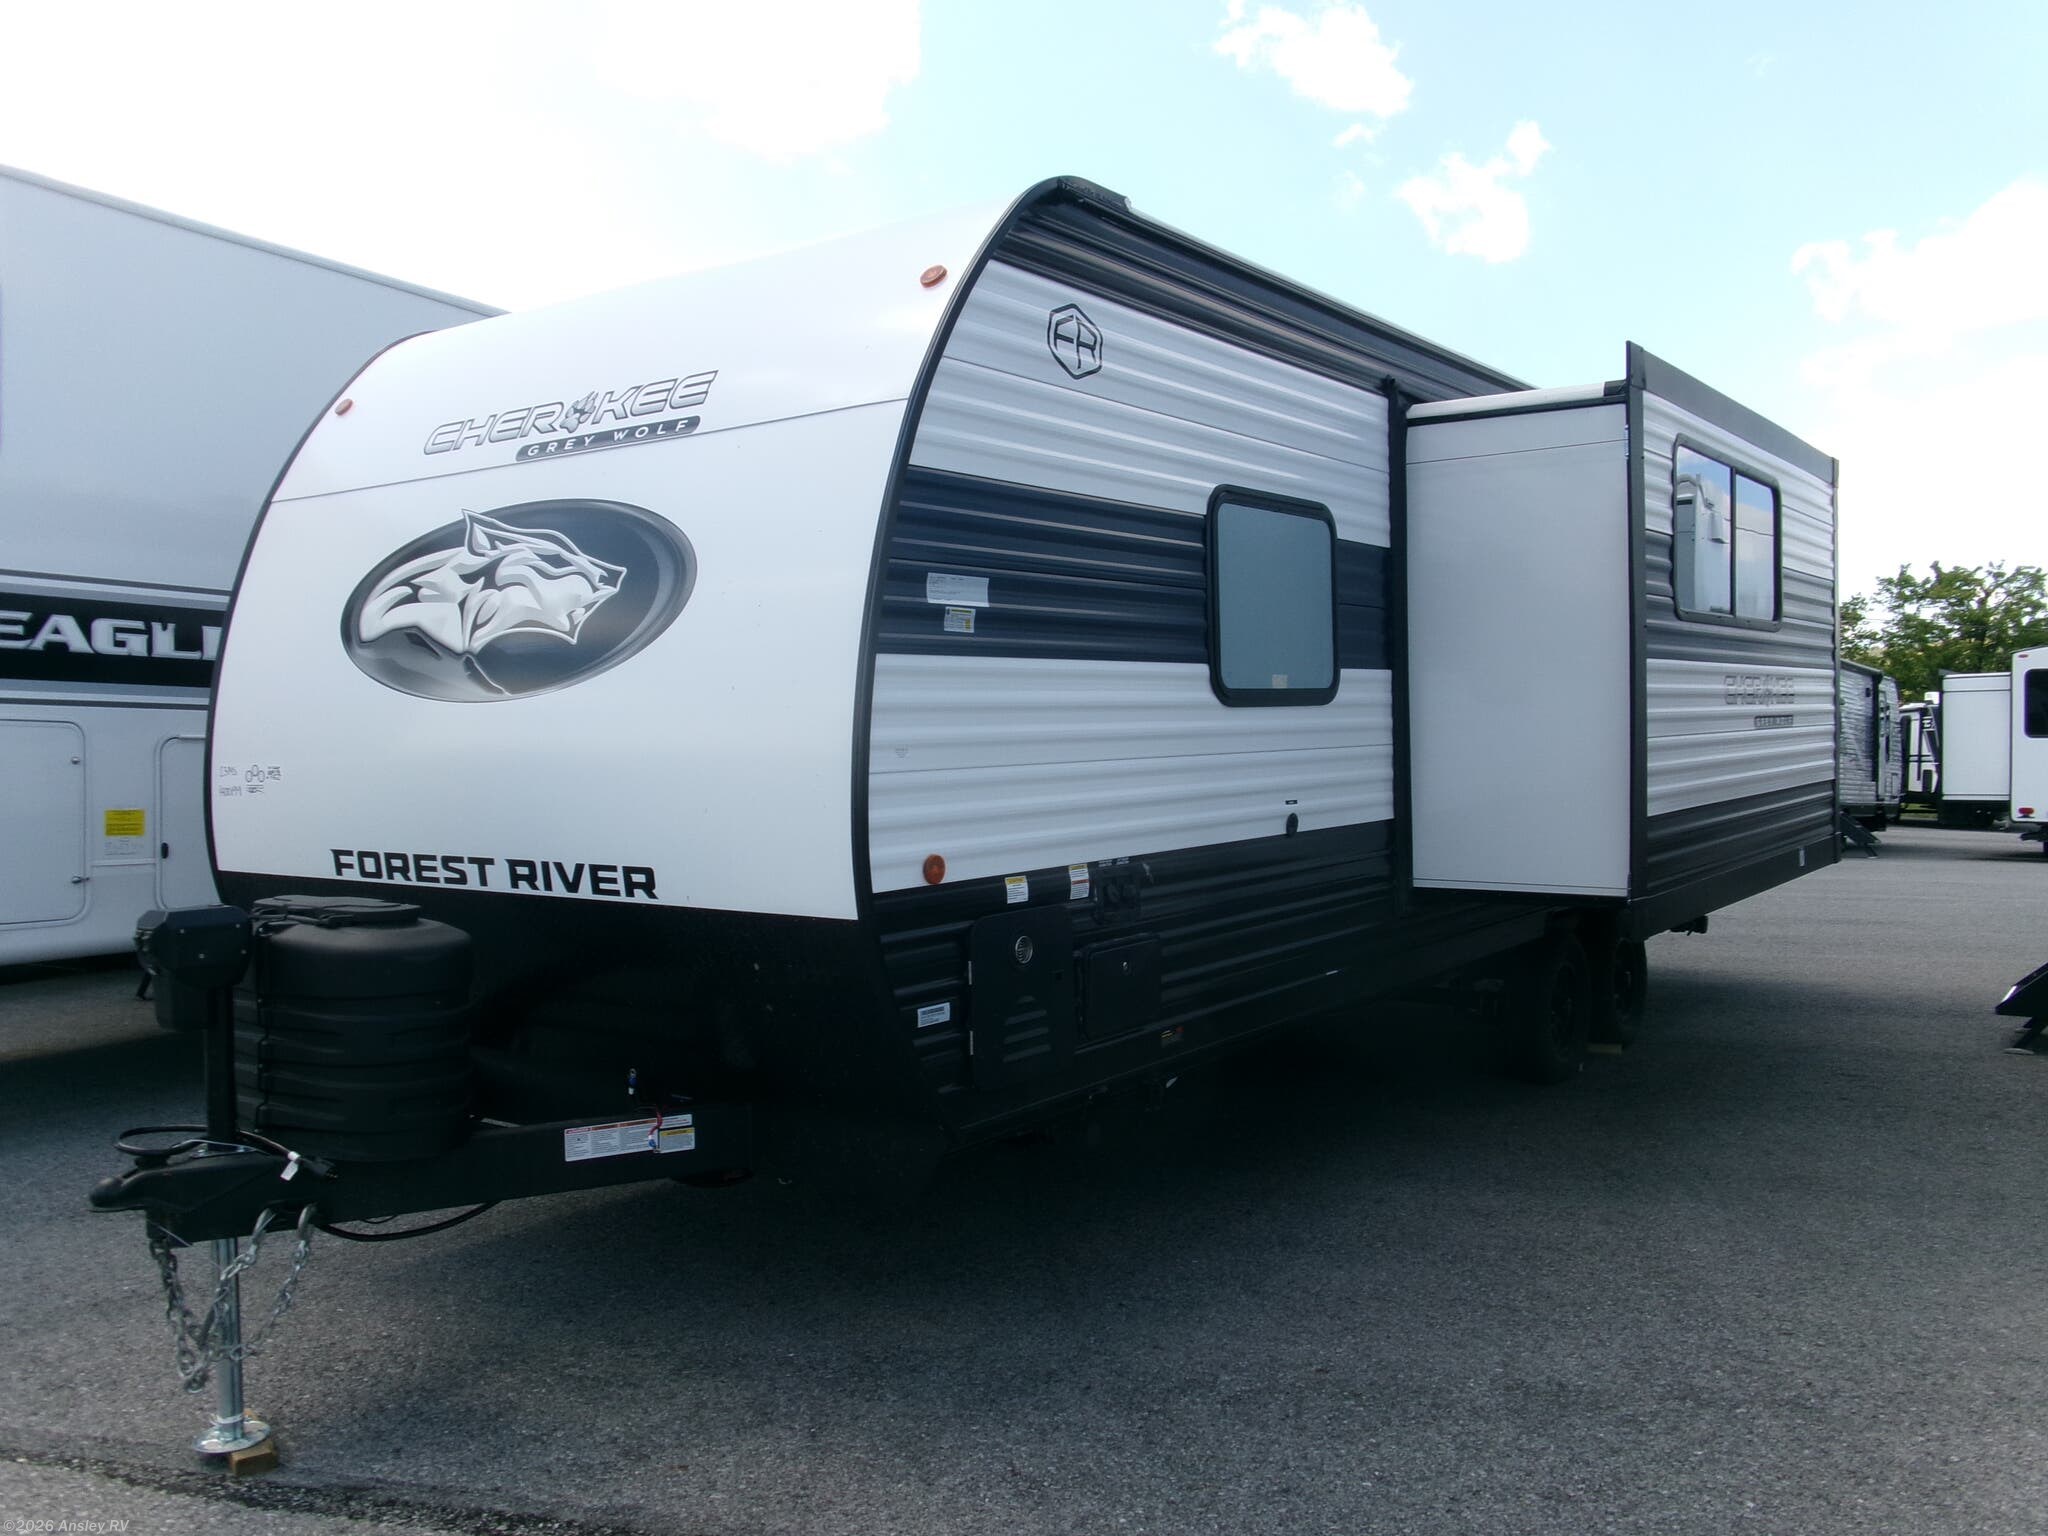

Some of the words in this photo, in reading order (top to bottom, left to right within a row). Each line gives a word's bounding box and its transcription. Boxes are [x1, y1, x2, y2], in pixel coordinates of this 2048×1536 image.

[527, 435, 595, 457] GREY
[613, 419, 689, 443] WOLF
[330, 849, 495, 887] FOREST
[504, 858, 660, 900] RIVER
